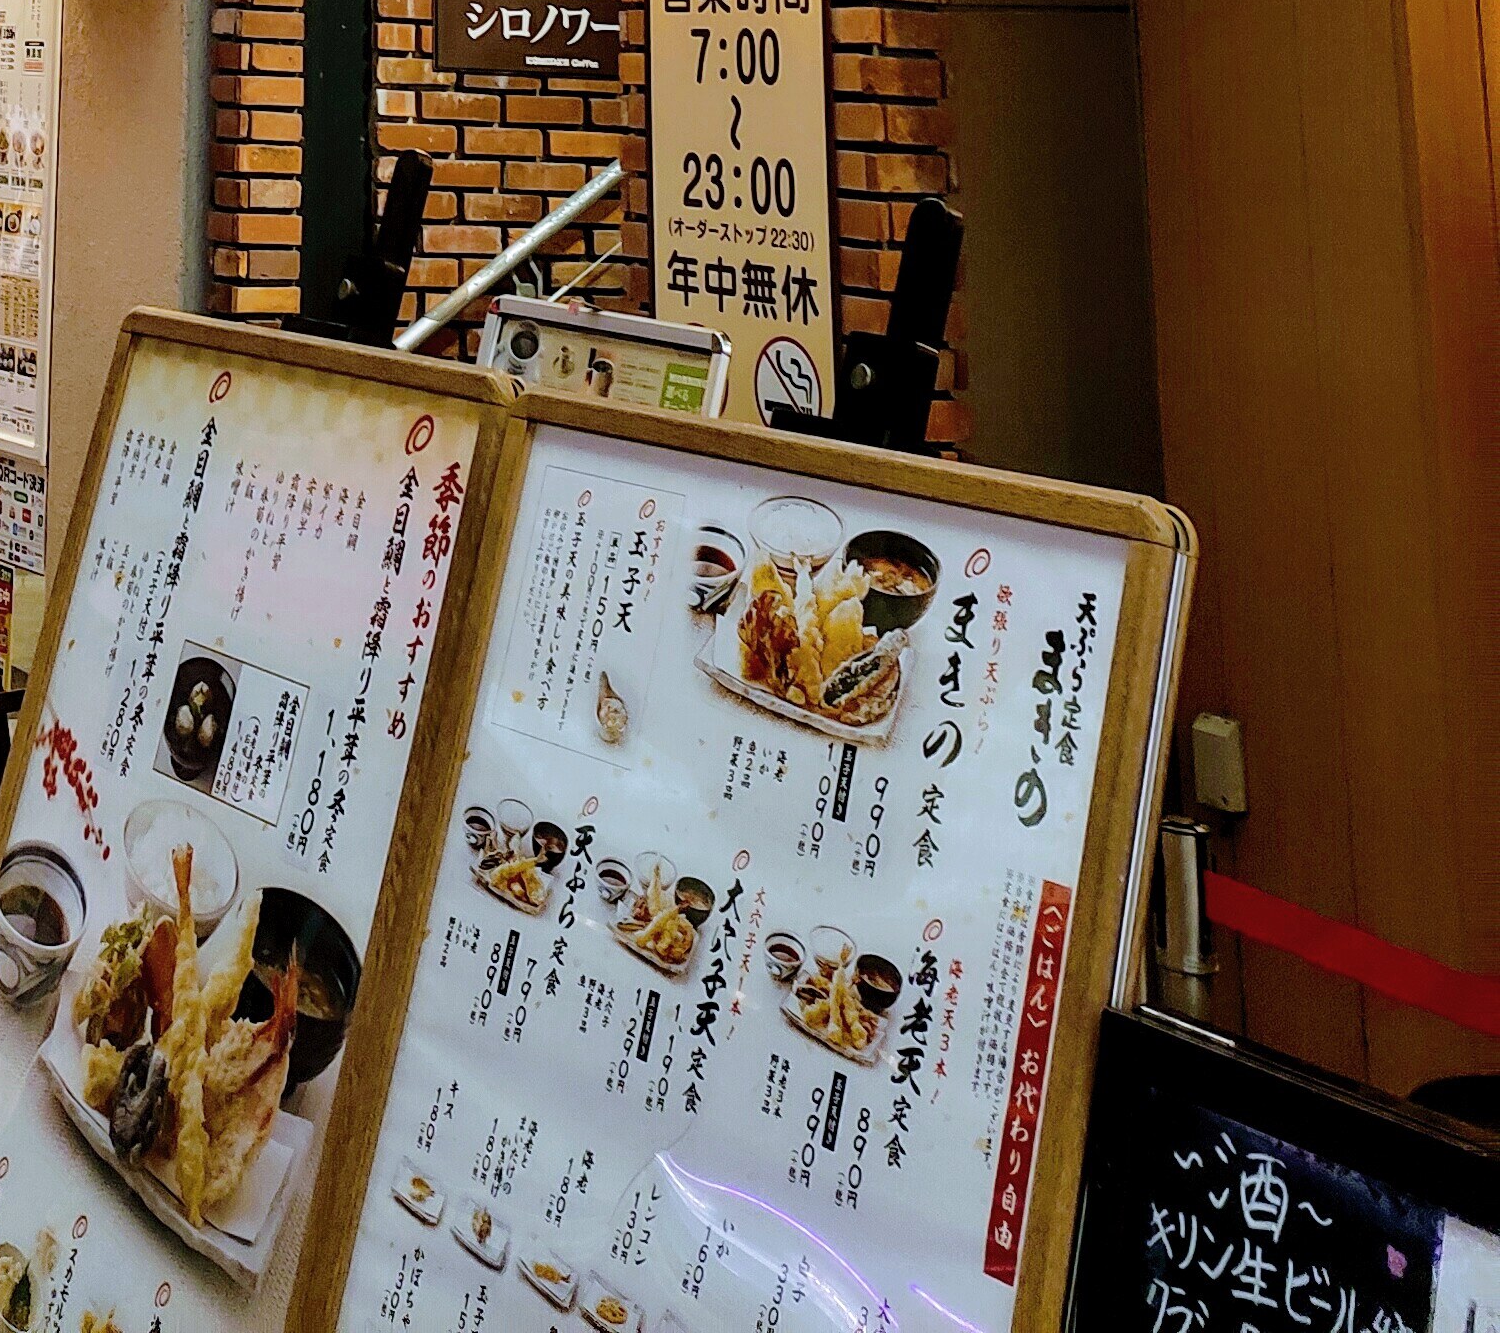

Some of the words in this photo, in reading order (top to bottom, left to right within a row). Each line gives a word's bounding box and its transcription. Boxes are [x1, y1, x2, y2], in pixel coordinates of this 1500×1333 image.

[690, 27, 781, 86] 7:00
[682, 151, 796, 218] 23:00
[666, 249, 820, 326] 年中無休
[387, 461, 464, 741] 季節のおすすめ
[537, 512, 587, 710] 玉子天の美味しい食べ方
[612, 531, 648, 633] 玉子天
[1055, 592, 1097, 766] 天ぷら定食
[913, 591, 979, 868] まきの定食
[1015, 630, 1066, 827] まきの
[864, 776, 889, 878] 990円
[544, 825, 596, 997] 天ぷら定食
[478, 943, 501, 1027] 890円
[512, 957, 537, 1043] 790円
[682, 878, 743, 1114] 大穴子天定食
[884, 947, 939, 1169] 海老天定食
[930, 958, 963, 1105] 海老天3本!
[425, 1087, 441, 1153] 180円
[444, 1080, 459, 1119] キス
[800, 1087, 824, 1188] 990円
[481, 1118, 498, 1185] 180円
[555, 1157, 574, 1228] 180円
[847, 1107, 870, 1209] 890円
[993, 1049, 1043, 1251] お代わり自由
[620, 1192, 640, 1264] 130円
[634, 1184, 661, 1265] レンコン
[690, 1227, 711, 1299] 160円
[716, 1219, 735, 1257] いか
[388, 1254, 407, 1323] 130円
[402, 1246, 425, 1326] かぼちゃ
